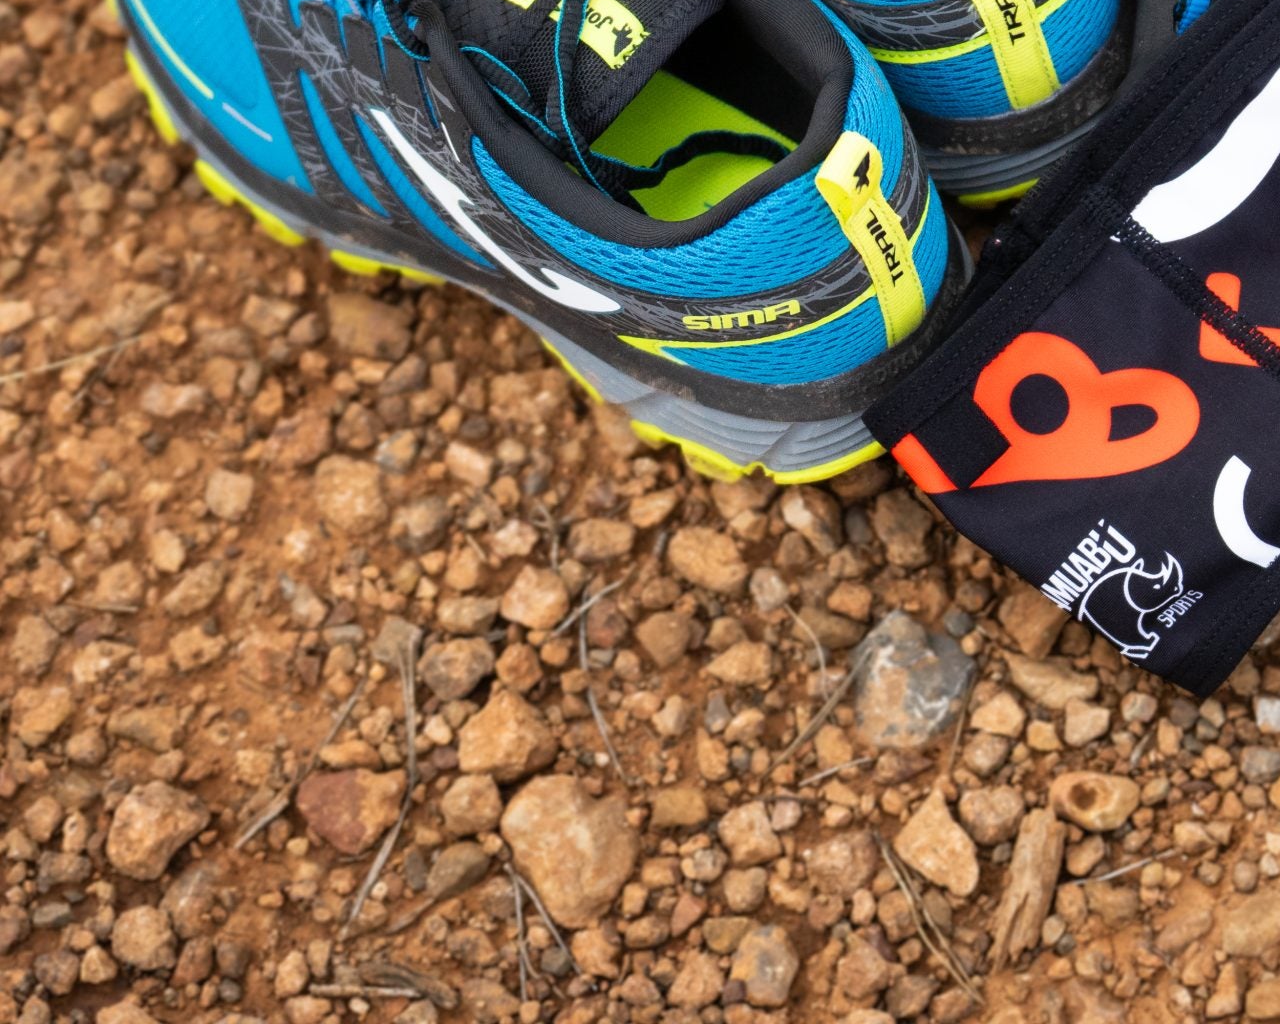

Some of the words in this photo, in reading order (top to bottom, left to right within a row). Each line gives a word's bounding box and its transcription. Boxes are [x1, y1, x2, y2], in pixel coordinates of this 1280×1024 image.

[866, 207, 904, 288] TRAIL
[682, 299, 801, 330] SIMA
[1157, 589, 1204, 628] SPORTS
